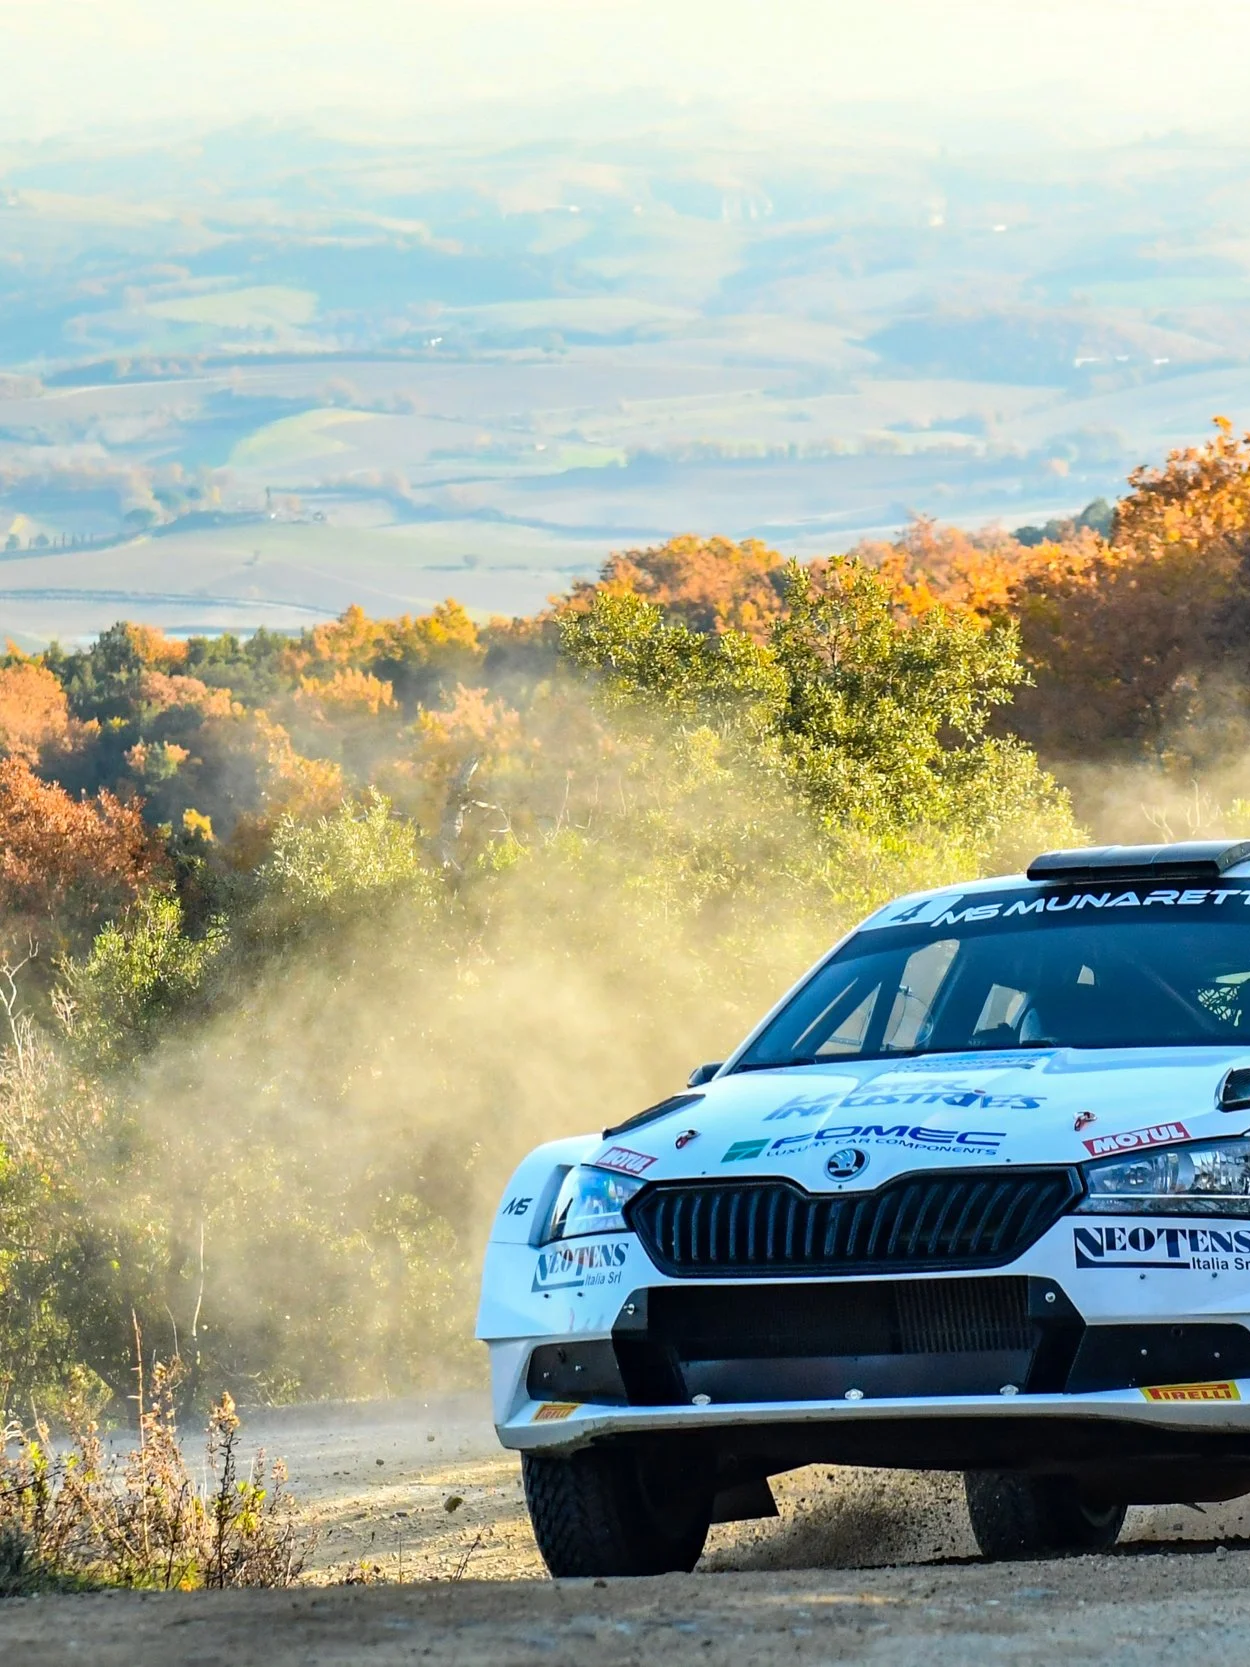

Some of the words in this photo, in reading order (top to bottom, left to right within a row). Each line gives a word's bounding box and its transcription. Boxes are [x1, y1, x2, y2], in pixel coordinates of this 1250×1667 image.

[890, 900, 932, 922] 4
[930, 903, 1004, 928] MS
[766, 1140, 830, 1157] LUXURY
[876, 1138, 997, 1156] COMPONENTS
[1094, 1124, 1186, 1155] MOTUL
[598, 1149, 652, 1171] MOTUL
[503, 1197, 533, 1216] MS
[534, 1243, 630, 1282] NEOTENS
[1191, 1257, 1230, 1271] Italia
[585, 1272, 606, 1287] Italia
[608, 1271, 622, 1285] Srl
[1147, 1383, 1232, 1400] PIRELLI
